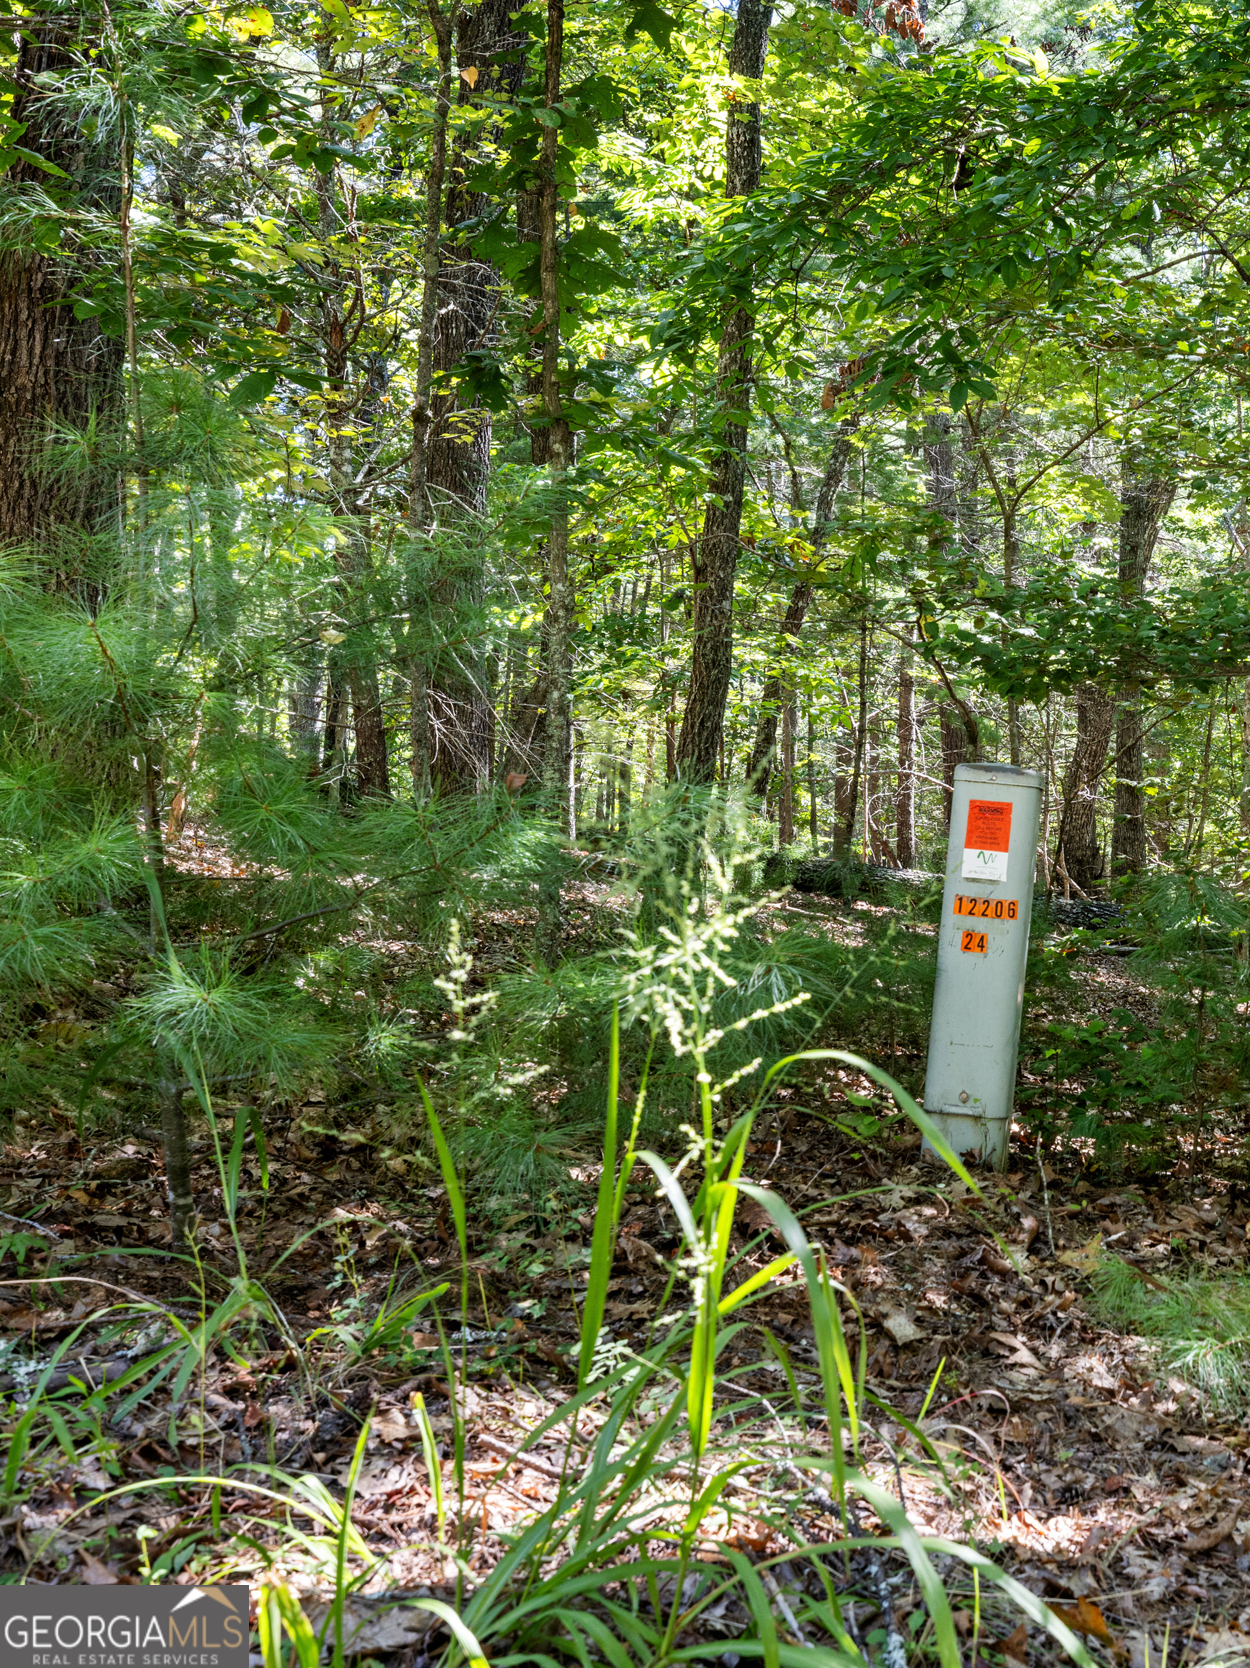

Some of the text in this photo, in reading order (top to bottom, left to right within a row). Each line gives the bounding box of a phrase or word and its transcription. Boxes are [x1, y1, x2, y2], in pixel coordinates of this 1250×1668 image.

[979, 807, 1003, 815] WARNING
[957, 896, 1016, 919] 12206
[963, 932, 986, 953] 24
